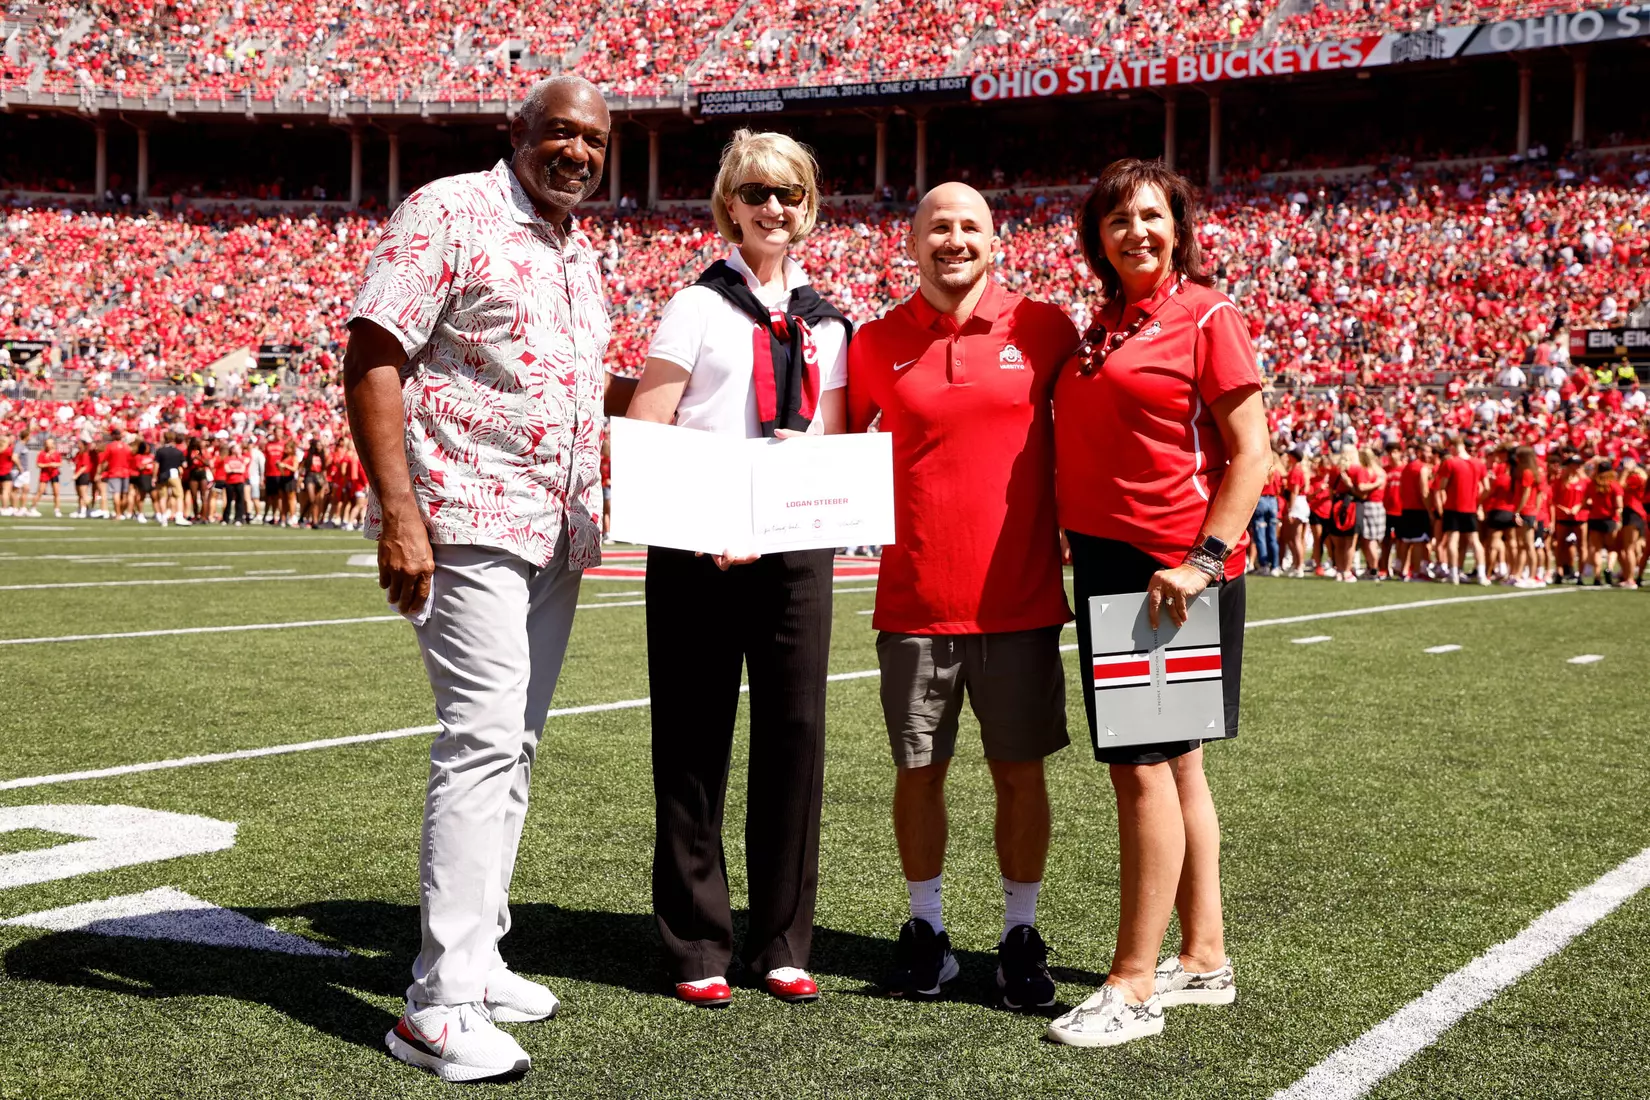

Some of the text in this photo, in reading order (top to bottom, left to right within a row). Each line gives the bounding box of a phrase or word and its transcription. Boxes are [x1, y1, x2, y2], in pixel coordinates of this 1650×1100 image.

[1489, 10, 1604, 51] OHIO
[971, 38, 1364, 101] OHIO STATE BUCKEYES
[700, 92, 735, 104] LOGAN
[879, 82, 901, 94] ONE
[901, 80, 917, 93] OF
[918, 79, 938, 91] THE
[938, 77, 968, 91] MOST
[700, 100, 784, 115] ACCOMPLISHED
[786, 497, 849, 508] LOGAN STIEBER
